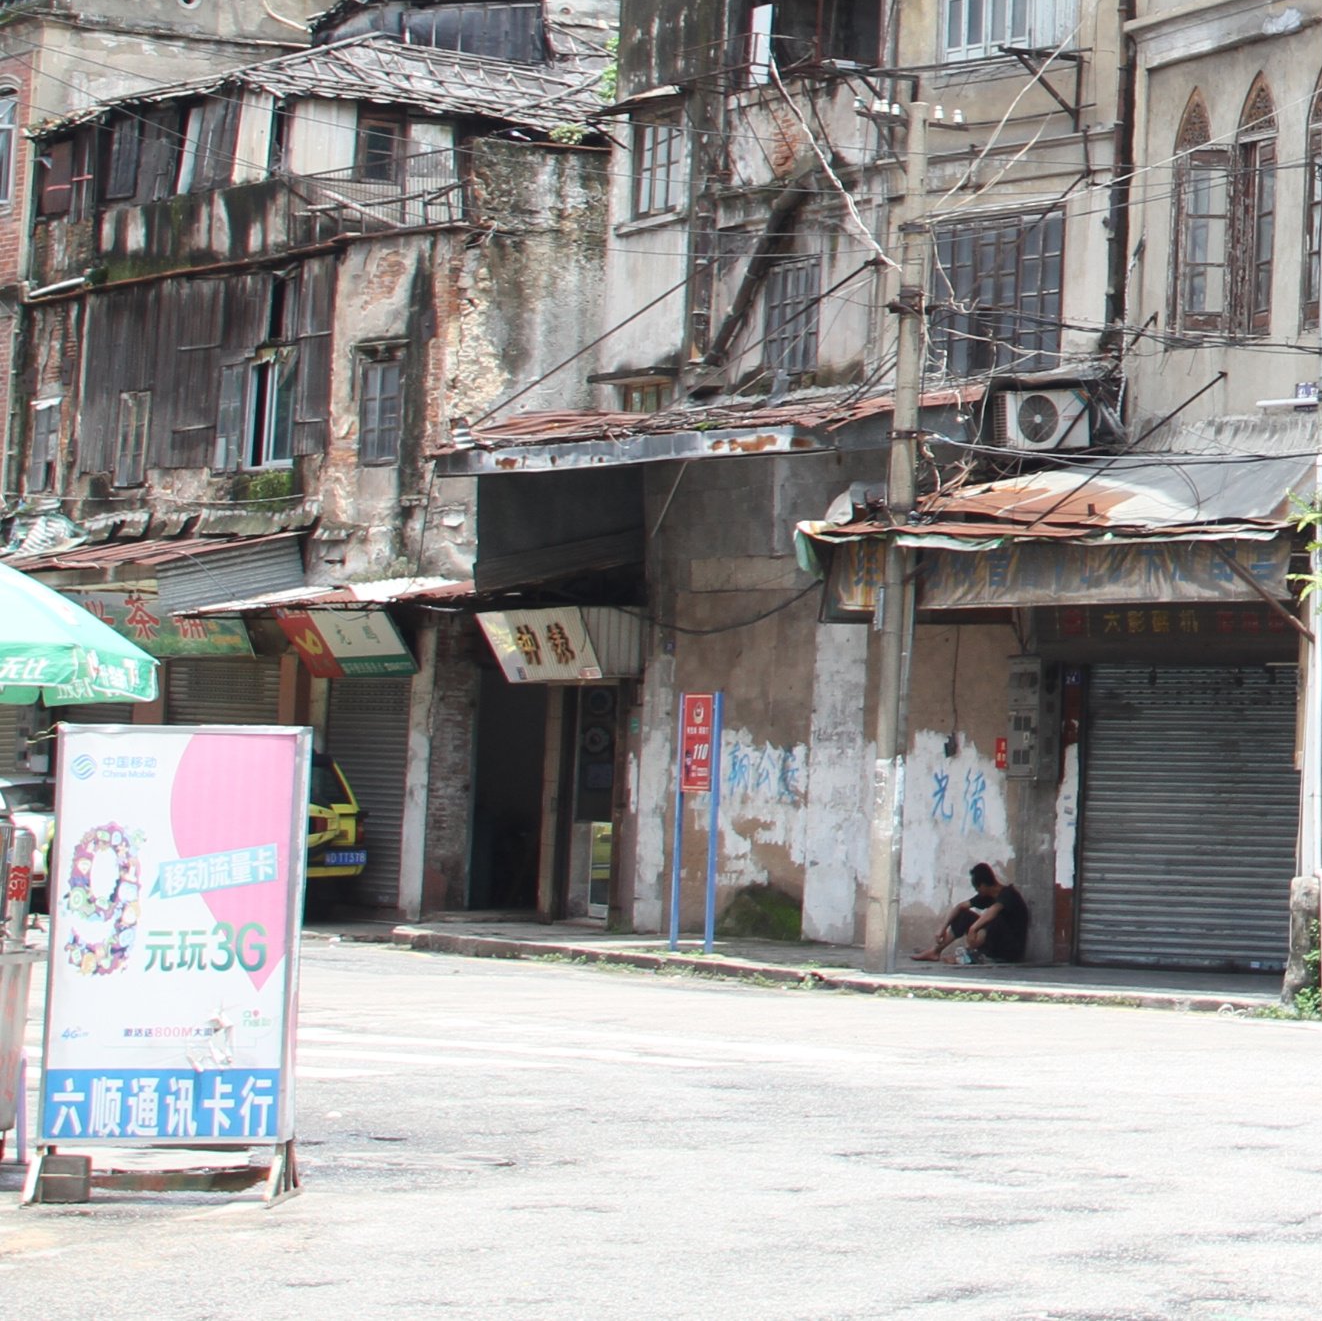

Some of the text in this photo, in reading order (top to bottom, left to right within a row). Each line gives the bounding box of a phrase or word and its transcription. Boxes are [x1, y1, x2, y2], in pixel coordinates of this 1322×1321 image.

[102, 756, 157, 768] 中国移动
[693, 744, 709, 760] 110
[102, 770, 156, 778] China Mobile
[163, 848, 275, 896] 移动流量卡
[144, 921, 267, 973] 元玩3G
[52, 1076, 274, 1137] 六顺通讯卡行
